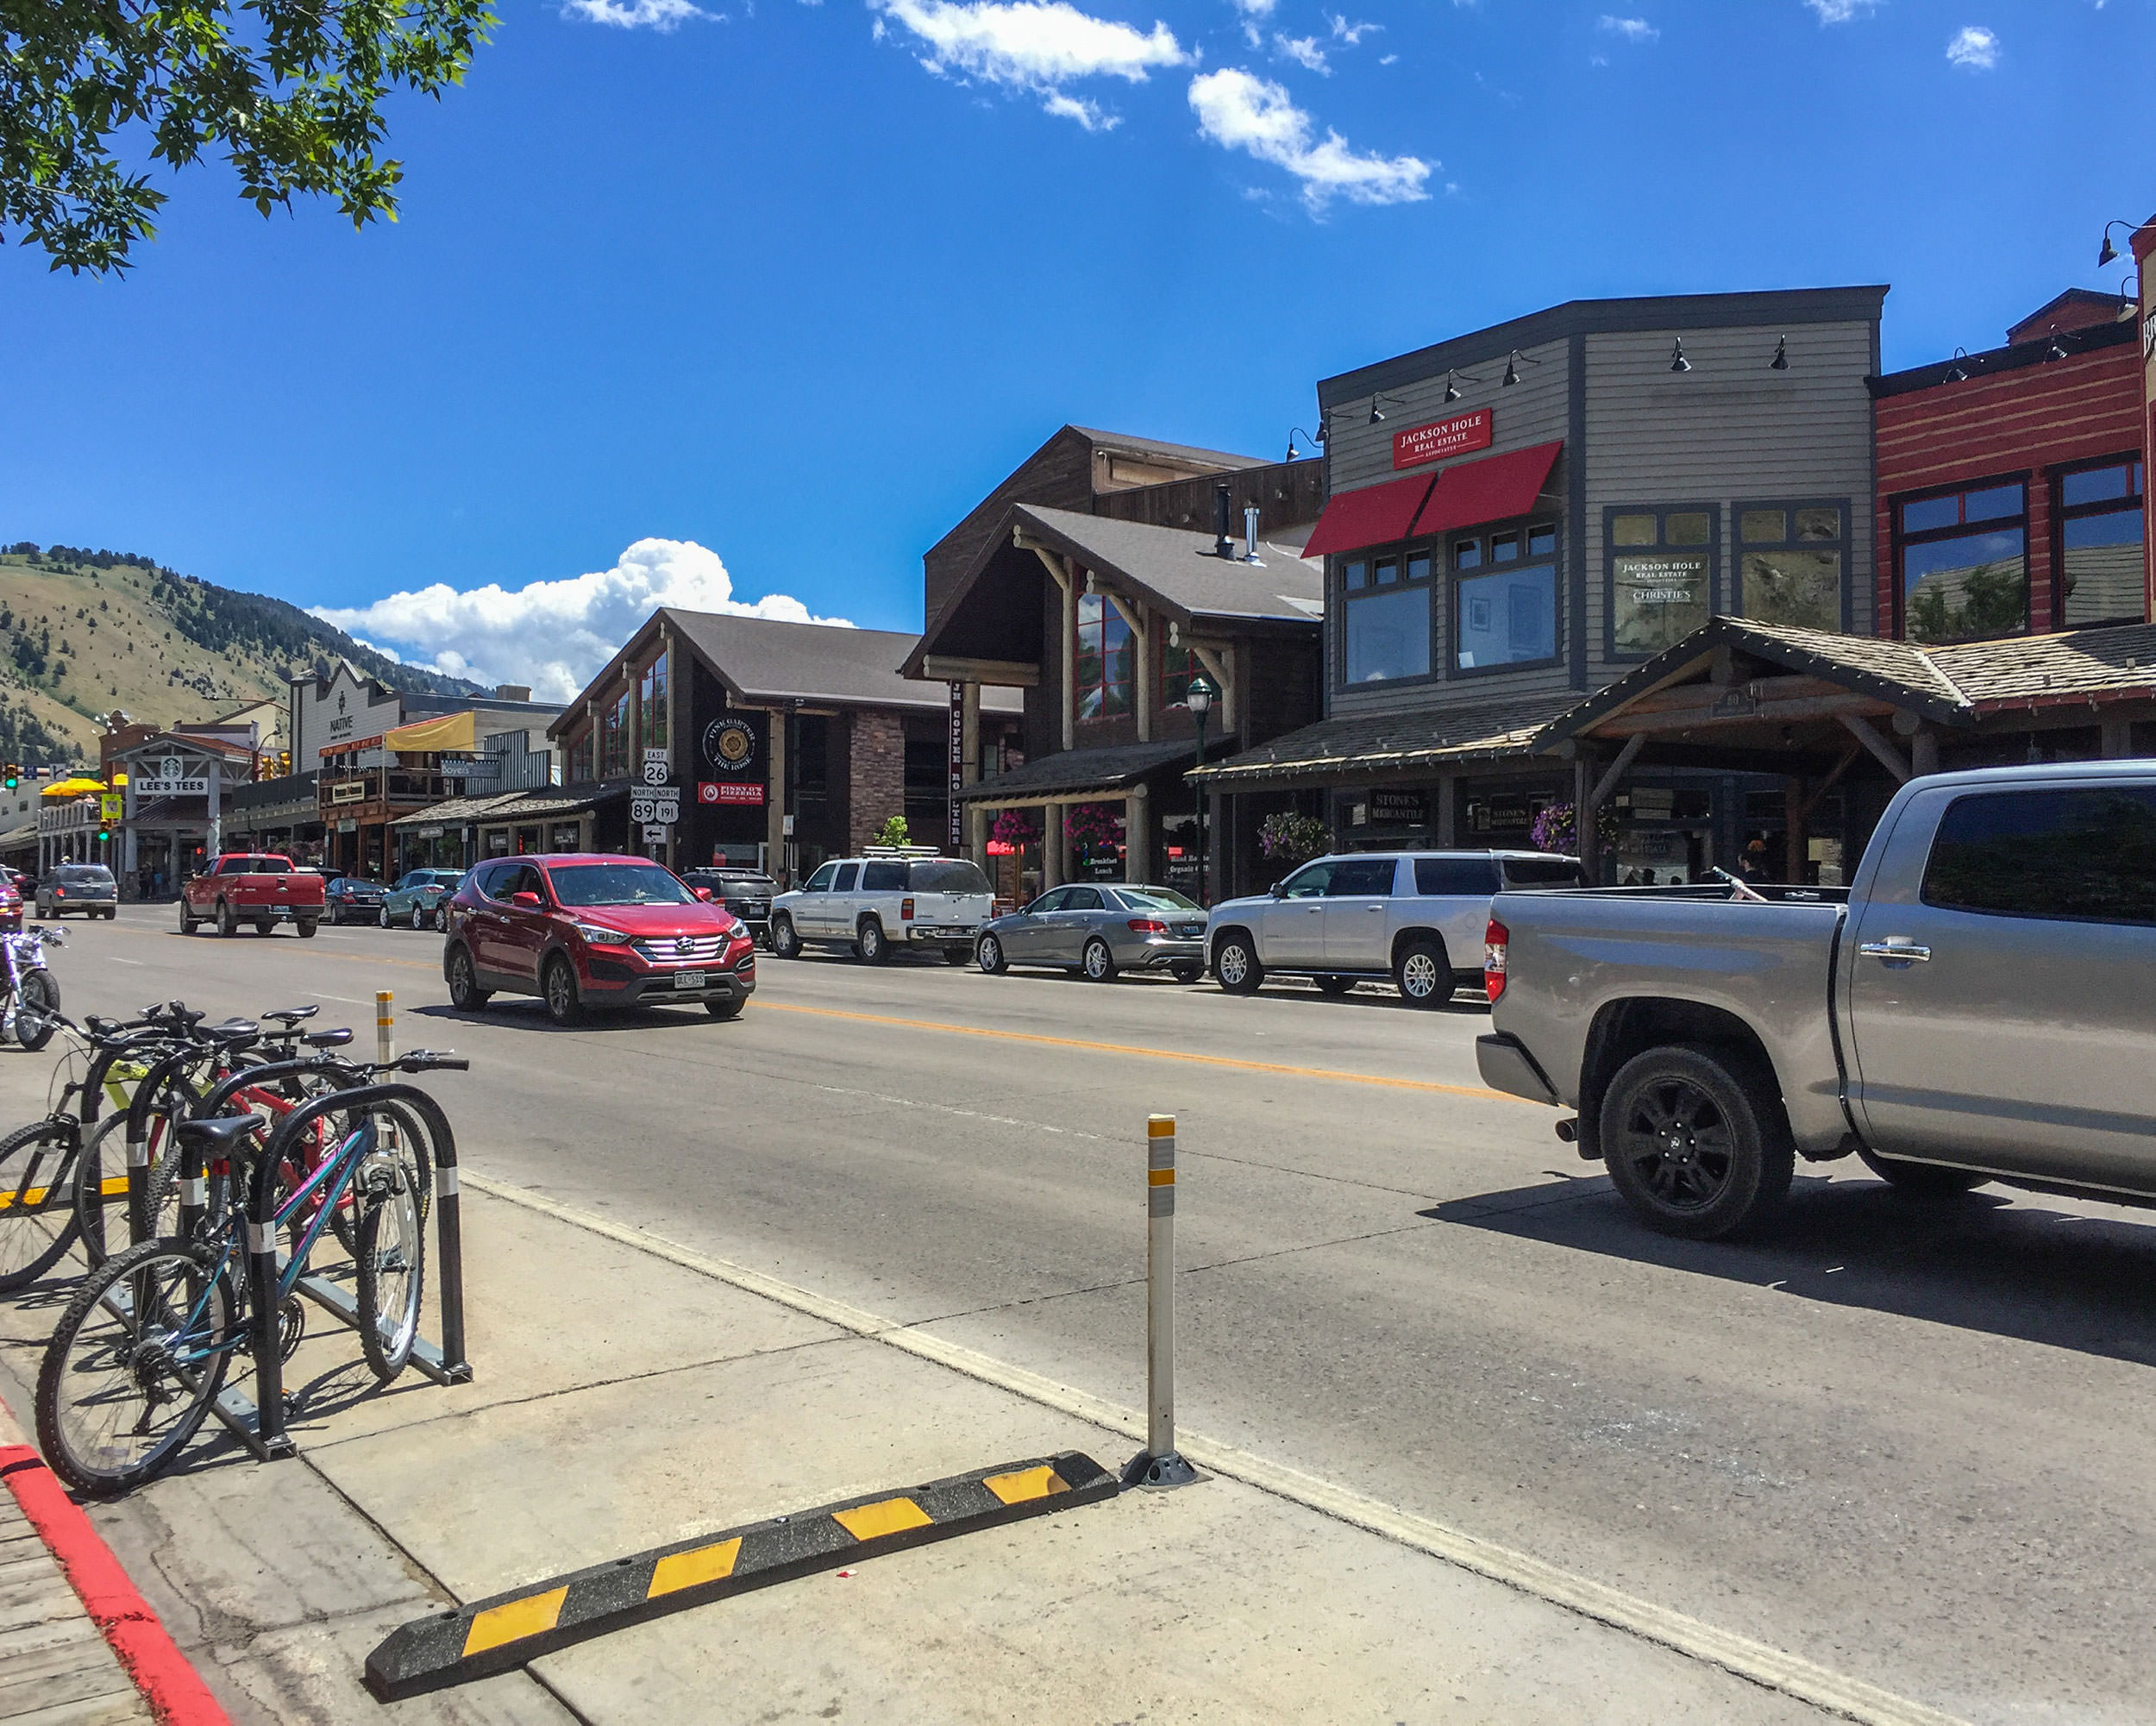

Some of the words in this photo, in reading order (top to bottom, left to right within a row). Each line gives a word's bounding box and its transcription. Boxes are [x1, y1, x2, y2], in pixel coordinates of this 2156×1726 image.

[1401, 424, 1449, 449] JACKSON
[1451, 416, 1482, 432] HOLE
[1414, 441, 1435, 453] REAL
[1438, 432, 1468, 447] ESTATE
[1622, 563, 1669, 573] JACKSON
[953, 683, 962, 700] JH
[330, 715, 354, 732] NATIVE
[709, 722, 725, 739] PINK
[726, 718, 755, 740] GARTER
[952, 710, 961, 763] COFFEE
[647, 767, 665, 780] 26
[140, 781, 171, 790] LEE'S
[175, 781, 204, 790] TEES
[632, 788, 655, 797] NORTH
[634, 804, 653, 817] 89
[661, 807, 674, 817] 191
[952, 773, 961, 844] ROSTERS
